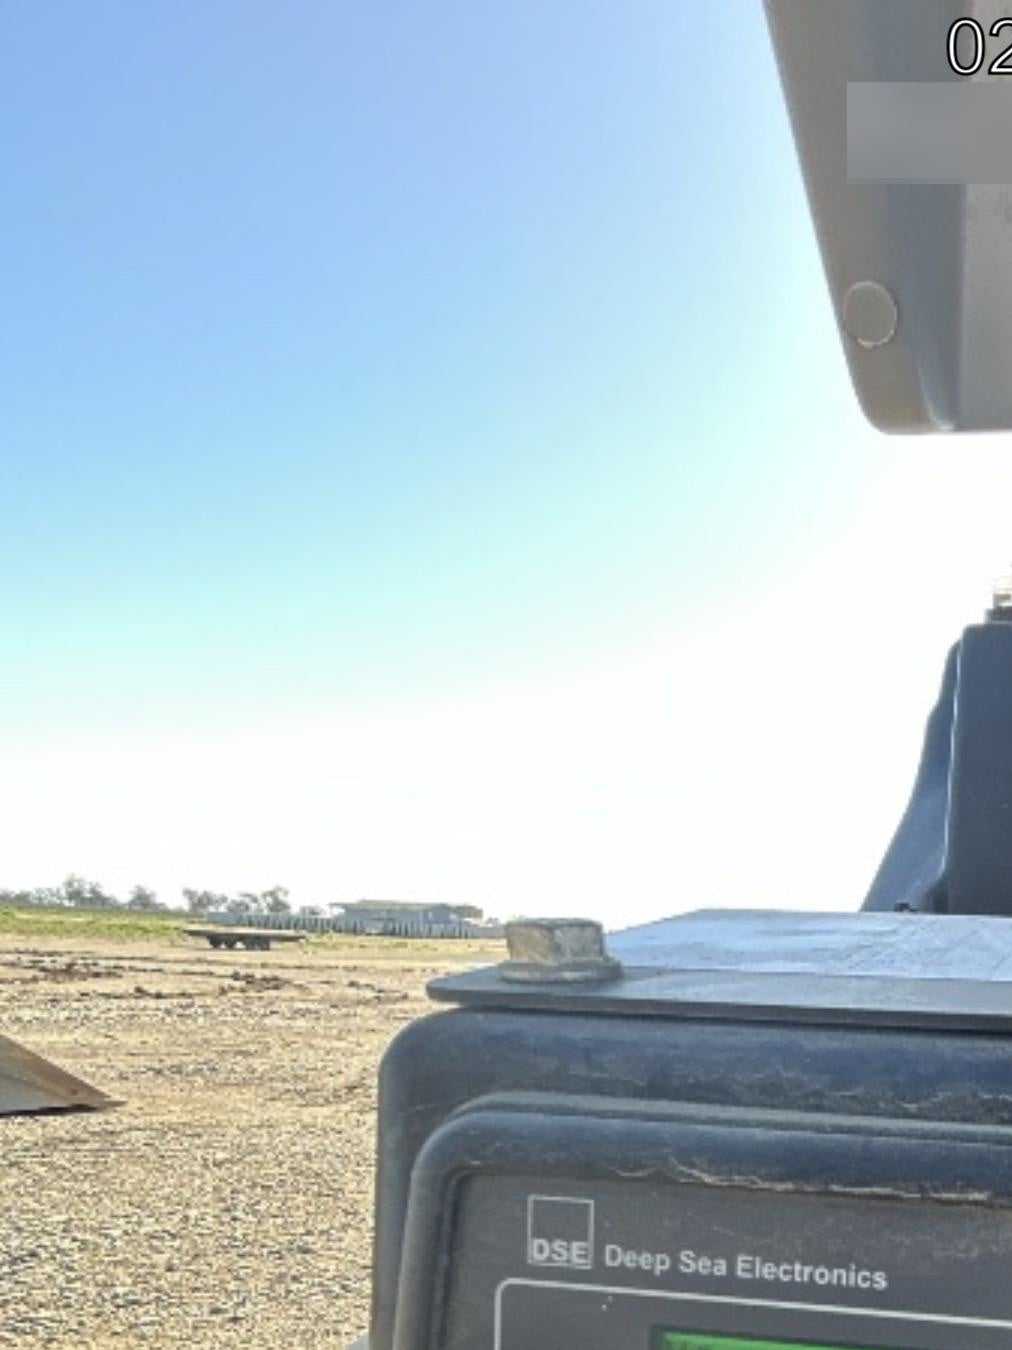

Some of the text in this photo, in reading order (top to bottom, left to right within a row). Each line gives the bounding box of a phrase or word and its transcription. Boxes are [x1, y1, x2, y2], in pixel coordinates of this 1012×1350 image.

[532, 1238, 590, 1263] DSE
[604, 1243, 889, 1291] Deep Sea Electronics
